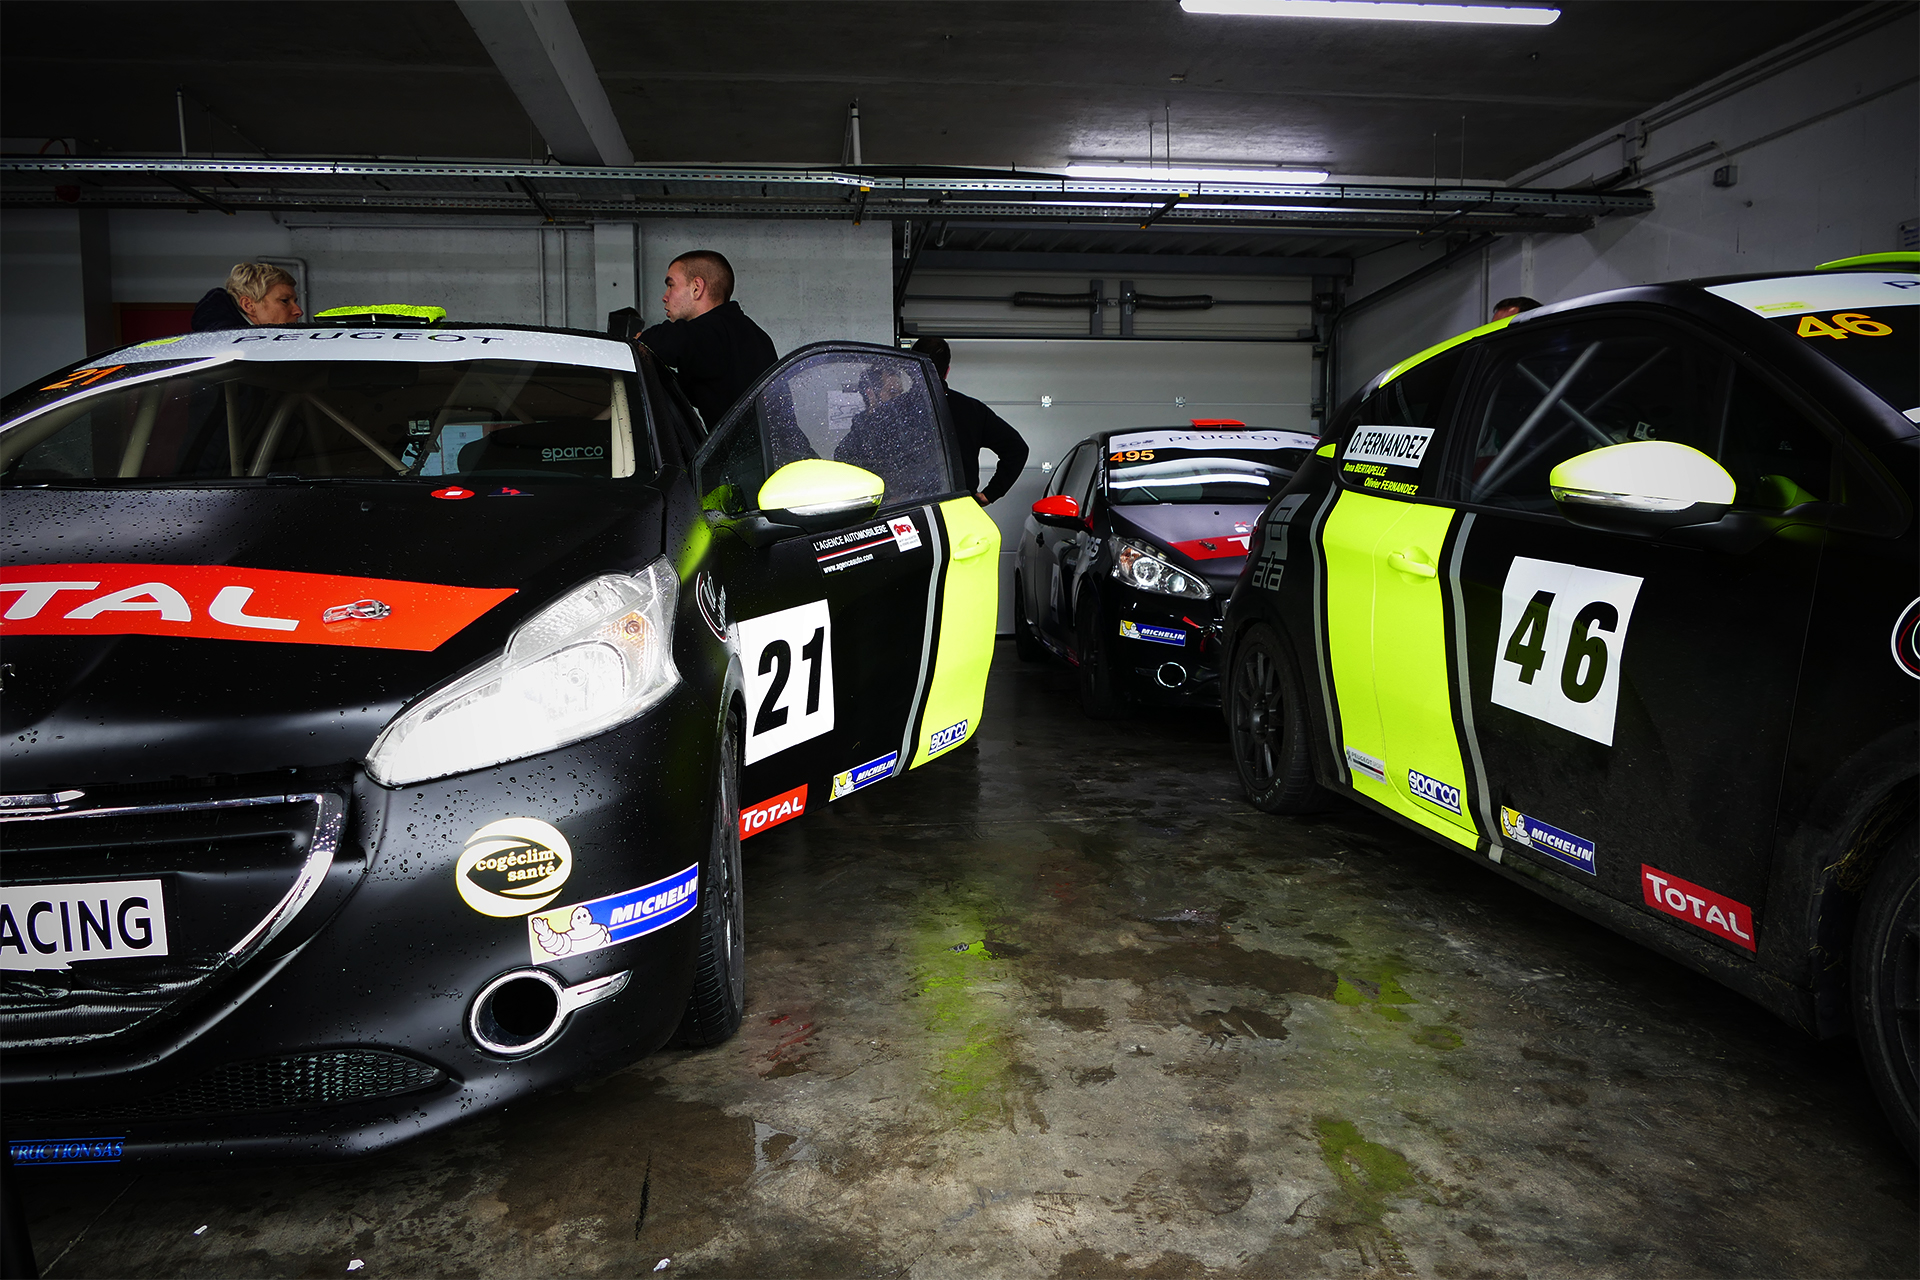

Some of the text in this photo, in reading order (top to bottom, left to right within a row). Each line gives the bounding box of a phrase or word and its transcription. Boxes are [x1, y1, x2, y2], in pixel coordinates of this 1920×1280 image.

[232, 332, 504, 345] PEUGEOT
[1797, 313, 1893, 340] 46
[39, 364, 126, 391] 21
[1168, 434, 1281, 443] PEUGEOT
[1359, 432, 1428, 460] FERNANDEZ
[541, 445, 604, 462] sparco
[1109, 450, 1155, 463] 495
[1354, 463, 1388, 477] BERTAPELLE
[1380, 480, 1419, 496] FERNANDEZ
[813, 535, 846, 552] L'AGENCE
[844, 524, 889, 543] AUTOMOBILIERE
[823, 553, 874, 574] www.agenceauto.com
[1252, 555, 1284, 591] ata
[1141, 628, 1185, 641] MICHELIN
[1503, 589, 1619, 704] 46
[753, 626, 825, 737] 21
[930, 720, 968, 750] sparco
[856, 757, 897, 782] MICHELIN
[1408, 771, 1459, 807] sparco
[742, 796, 804, 832] TOTAL
[1531, 827, 1593, 862] MICHELIN
[475, 847, 556, 872] cogéclim
[507, 861, 556, 882] santé
[609, 875, 698, 926] MICHELIN
[1646, 872, 1750, 940] TOTAL
[0, 896, 153, 955] ACING
[93, 1141, 124, 1158] SAS
